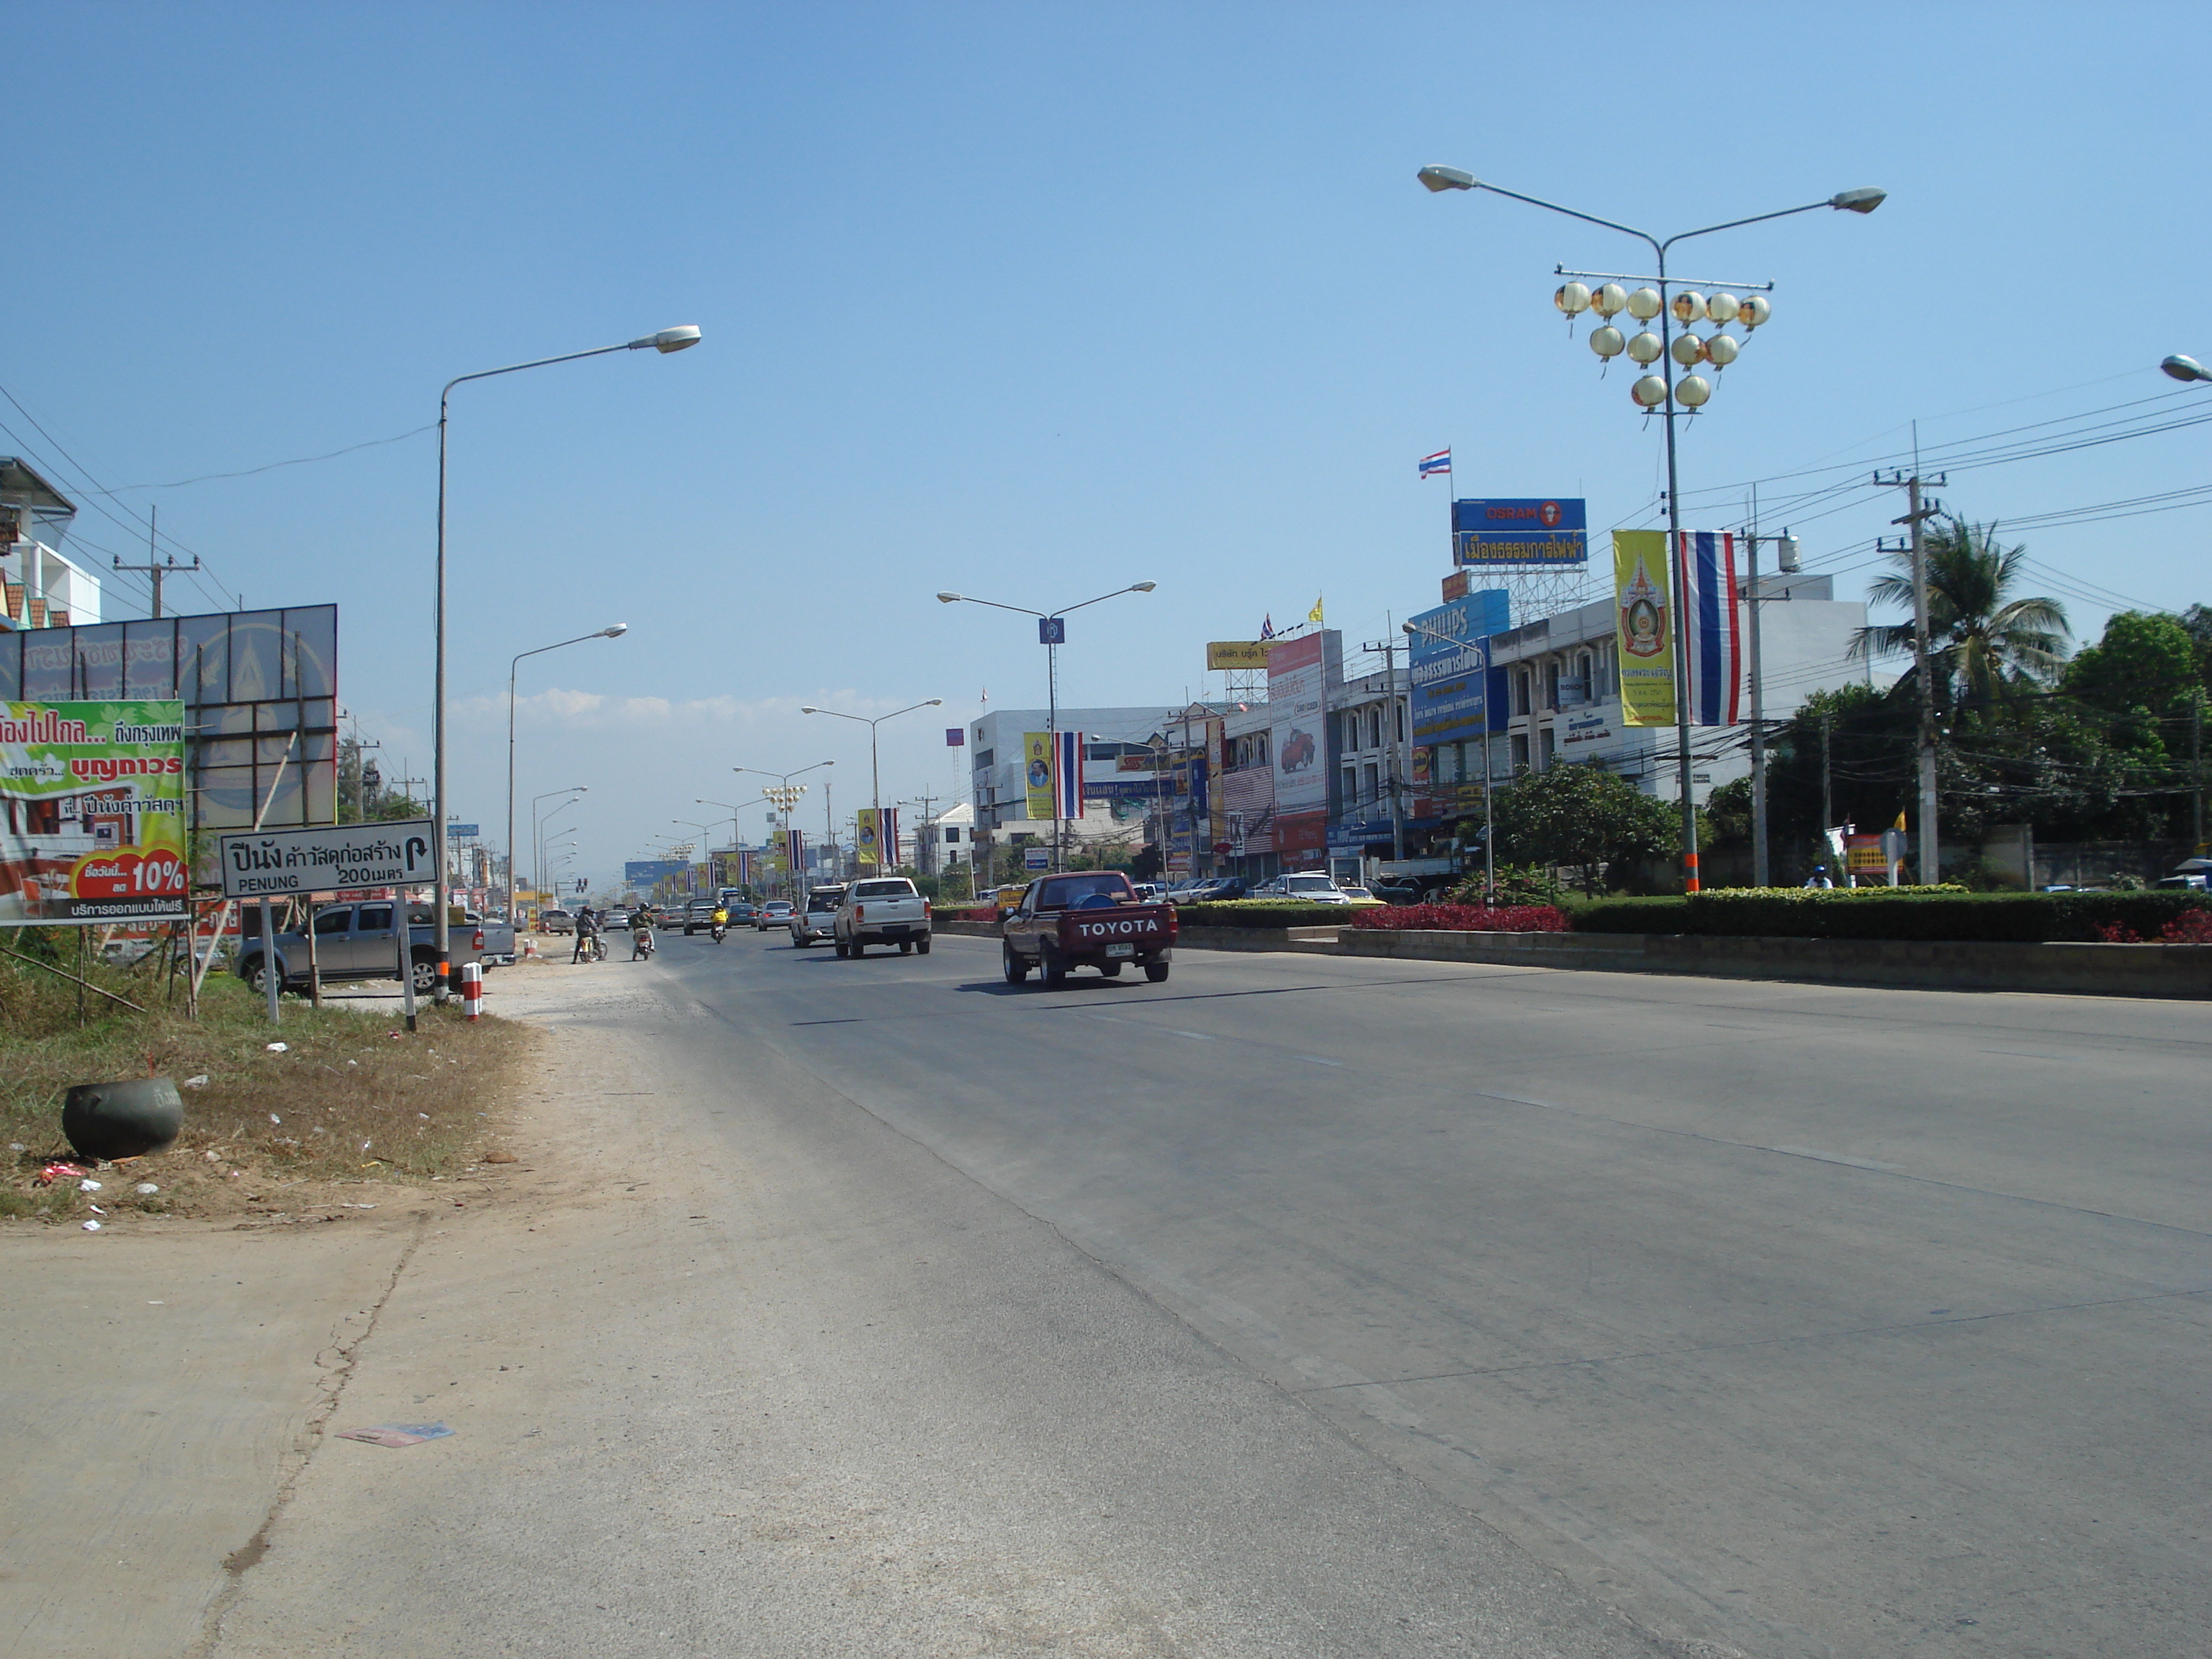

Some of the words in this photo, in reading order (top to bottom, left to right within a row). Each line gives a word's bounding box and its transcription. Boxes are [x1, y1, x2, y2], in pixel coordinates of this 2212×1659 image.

[1486, 508, 1537, 519] OSRAM
[1421, 606, 1468, 648] PHILIPS
[229, 840, 282, 871] ปีนัง
[285, 840, 401, 871] ค้าวัสดุก่อสร้าง
[132, 860, 185, 892] 10%
[238, 876, 299, 892] PENUNG
[1079, 919, 1159, 937] TOYOTA
